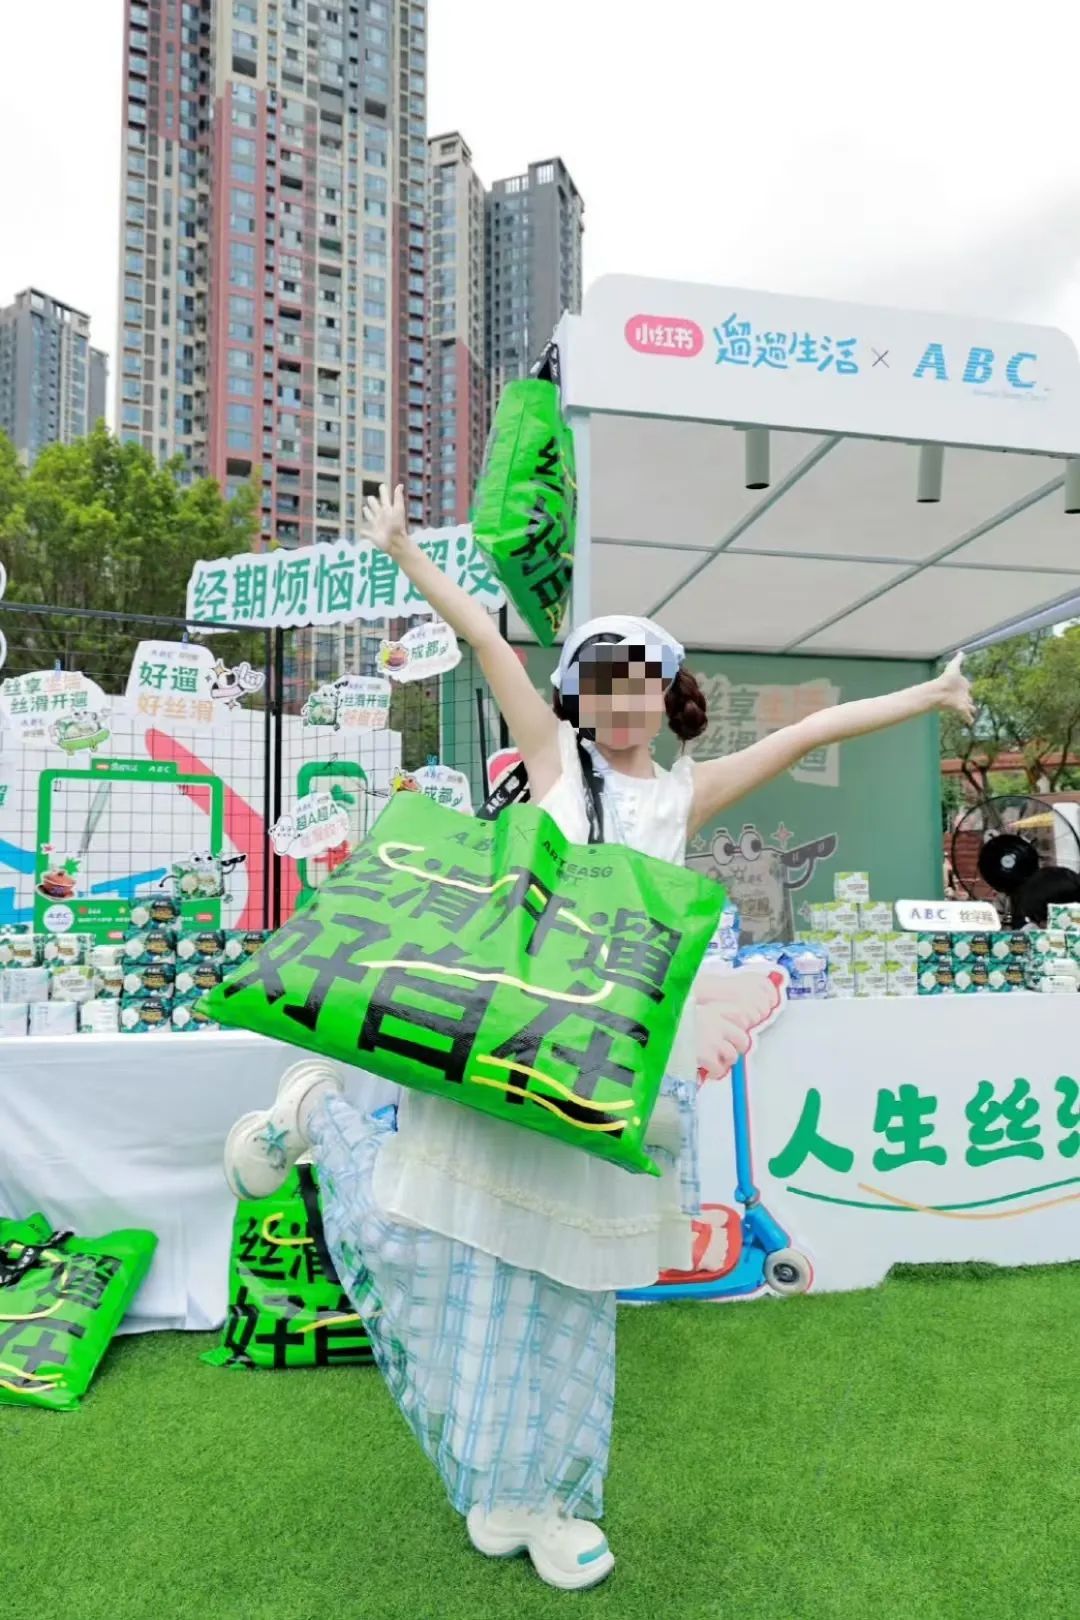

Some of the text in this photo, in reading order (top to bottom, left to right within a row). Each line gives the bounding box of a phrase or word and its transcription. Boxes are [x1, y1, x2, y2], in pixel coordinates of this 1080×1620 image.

[634, 324, 695, 349] 小红书
[713, 311, 859, 376] 遛遛生活
[912, 342, 1038, 390] ABC
[139, 661, 199, 693] 好遛
[138, 694, 214, 722] 好丝滑
[910, 907, 946, 921] ABC
[224, 902, 650, 1138] 好自在
